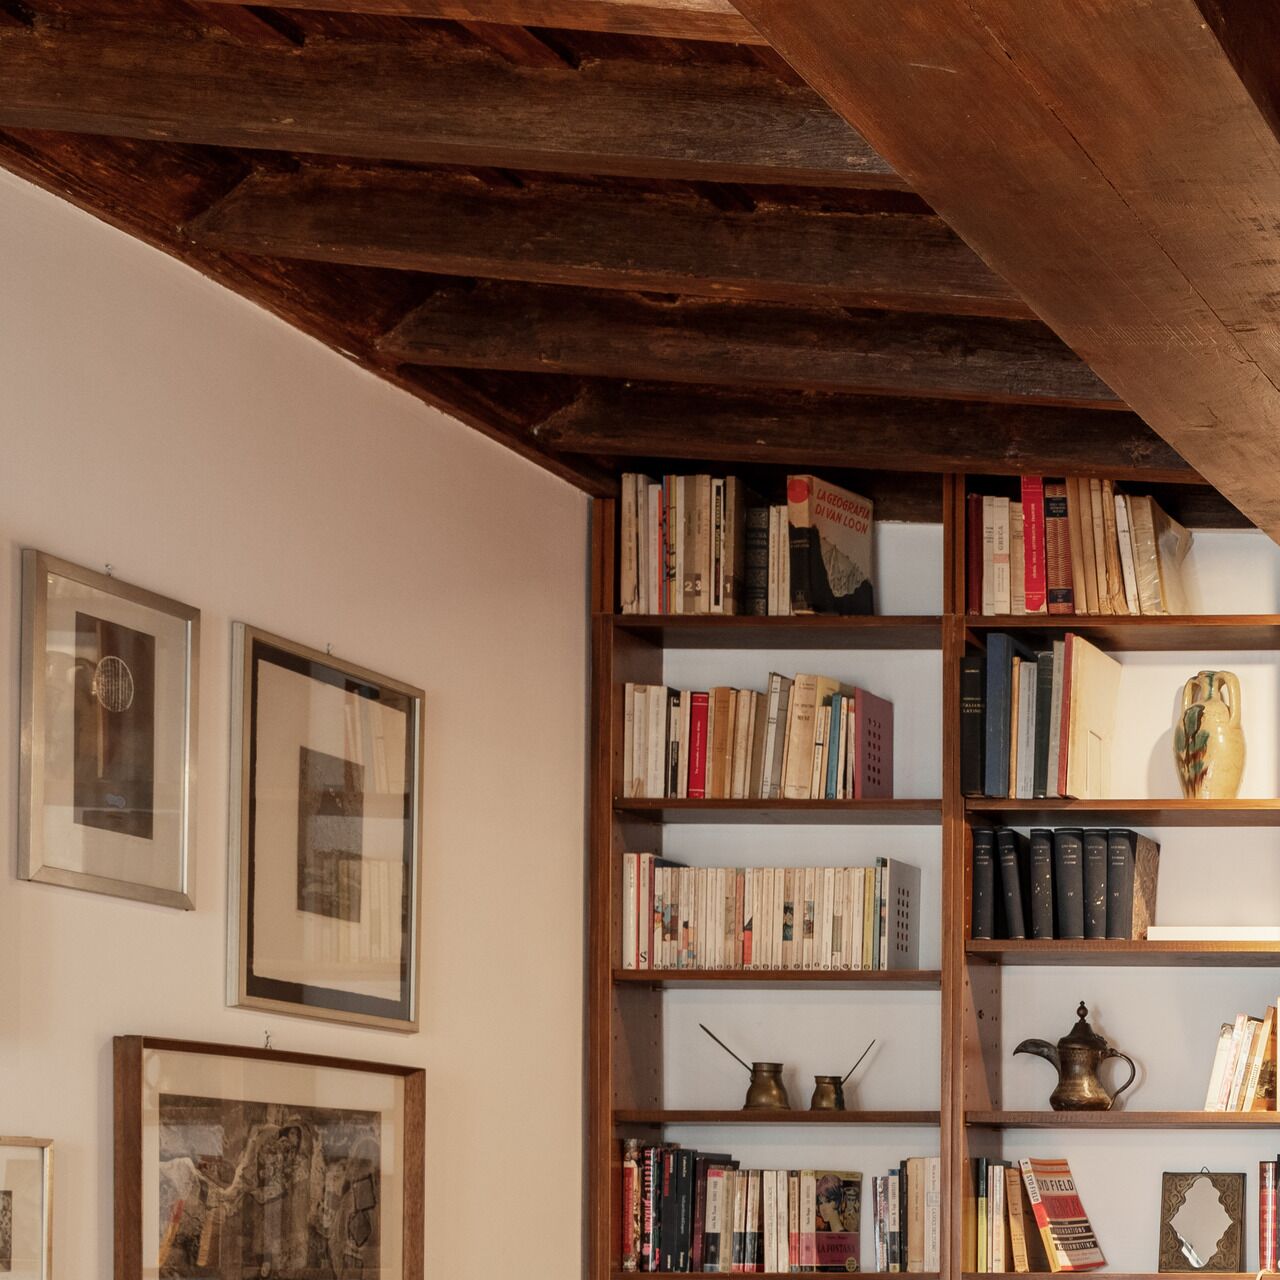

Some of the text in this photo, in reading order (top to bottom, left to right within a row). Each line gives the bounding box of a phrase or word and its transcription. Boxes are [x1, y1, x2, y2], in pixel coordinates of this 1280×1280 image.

[816, 489, 871, 521] LA GEOGRAFIA
[815, 503, 869, 535] DI VAN LOON
[684, 581, 694, 592] 2
[696, 580, 703, 591] 3
[725, 582, 732, 593] 1
[1037, 1179, 1074, 1191] SYD FIELD
[1029, 1184, 1040, 1202] FIELD
[827, 1244, 857, 1254] FONTANA
